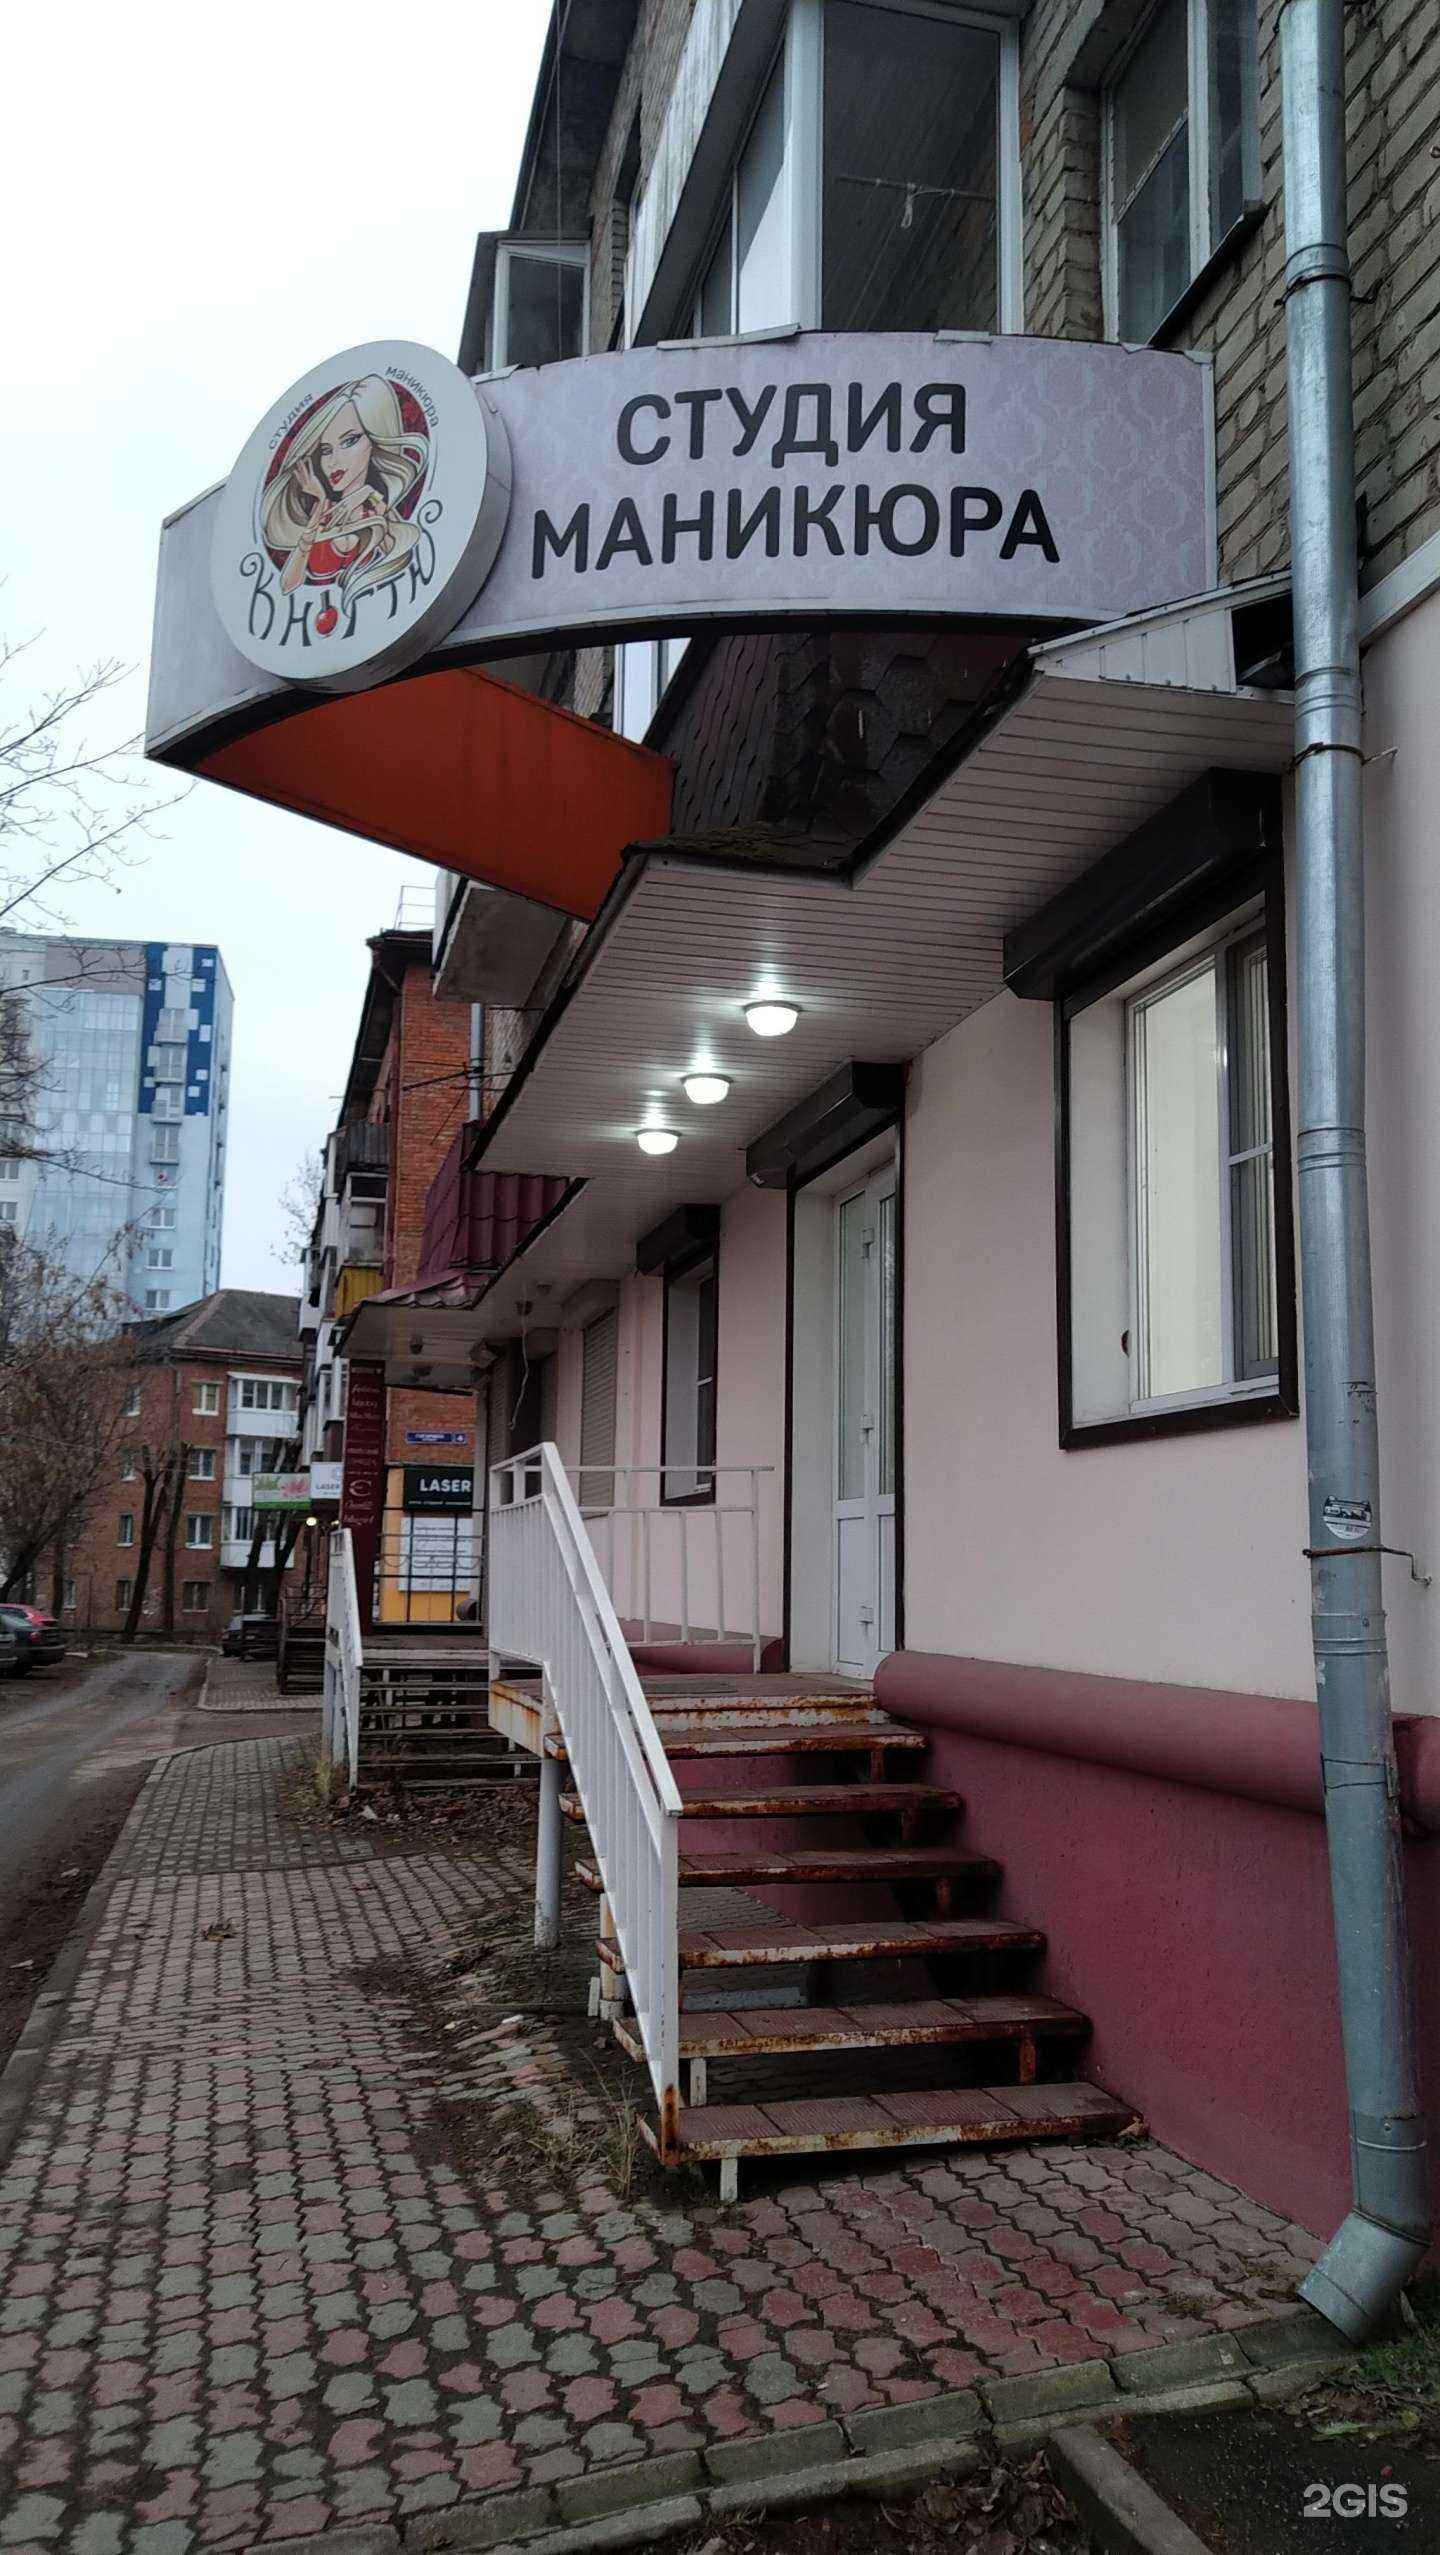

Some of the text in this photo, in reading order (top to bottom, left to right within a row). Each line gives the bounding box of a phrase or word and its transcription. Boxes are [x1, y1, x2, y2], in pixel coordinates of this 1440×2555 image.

[268, 366, 439, 451] студия маникюра
[617, 381, 966, 468] СТУДИЯ
[531, 483, 1060, 579] МАНИКЮРА
[420, 1478, 472, 1492] LASER
